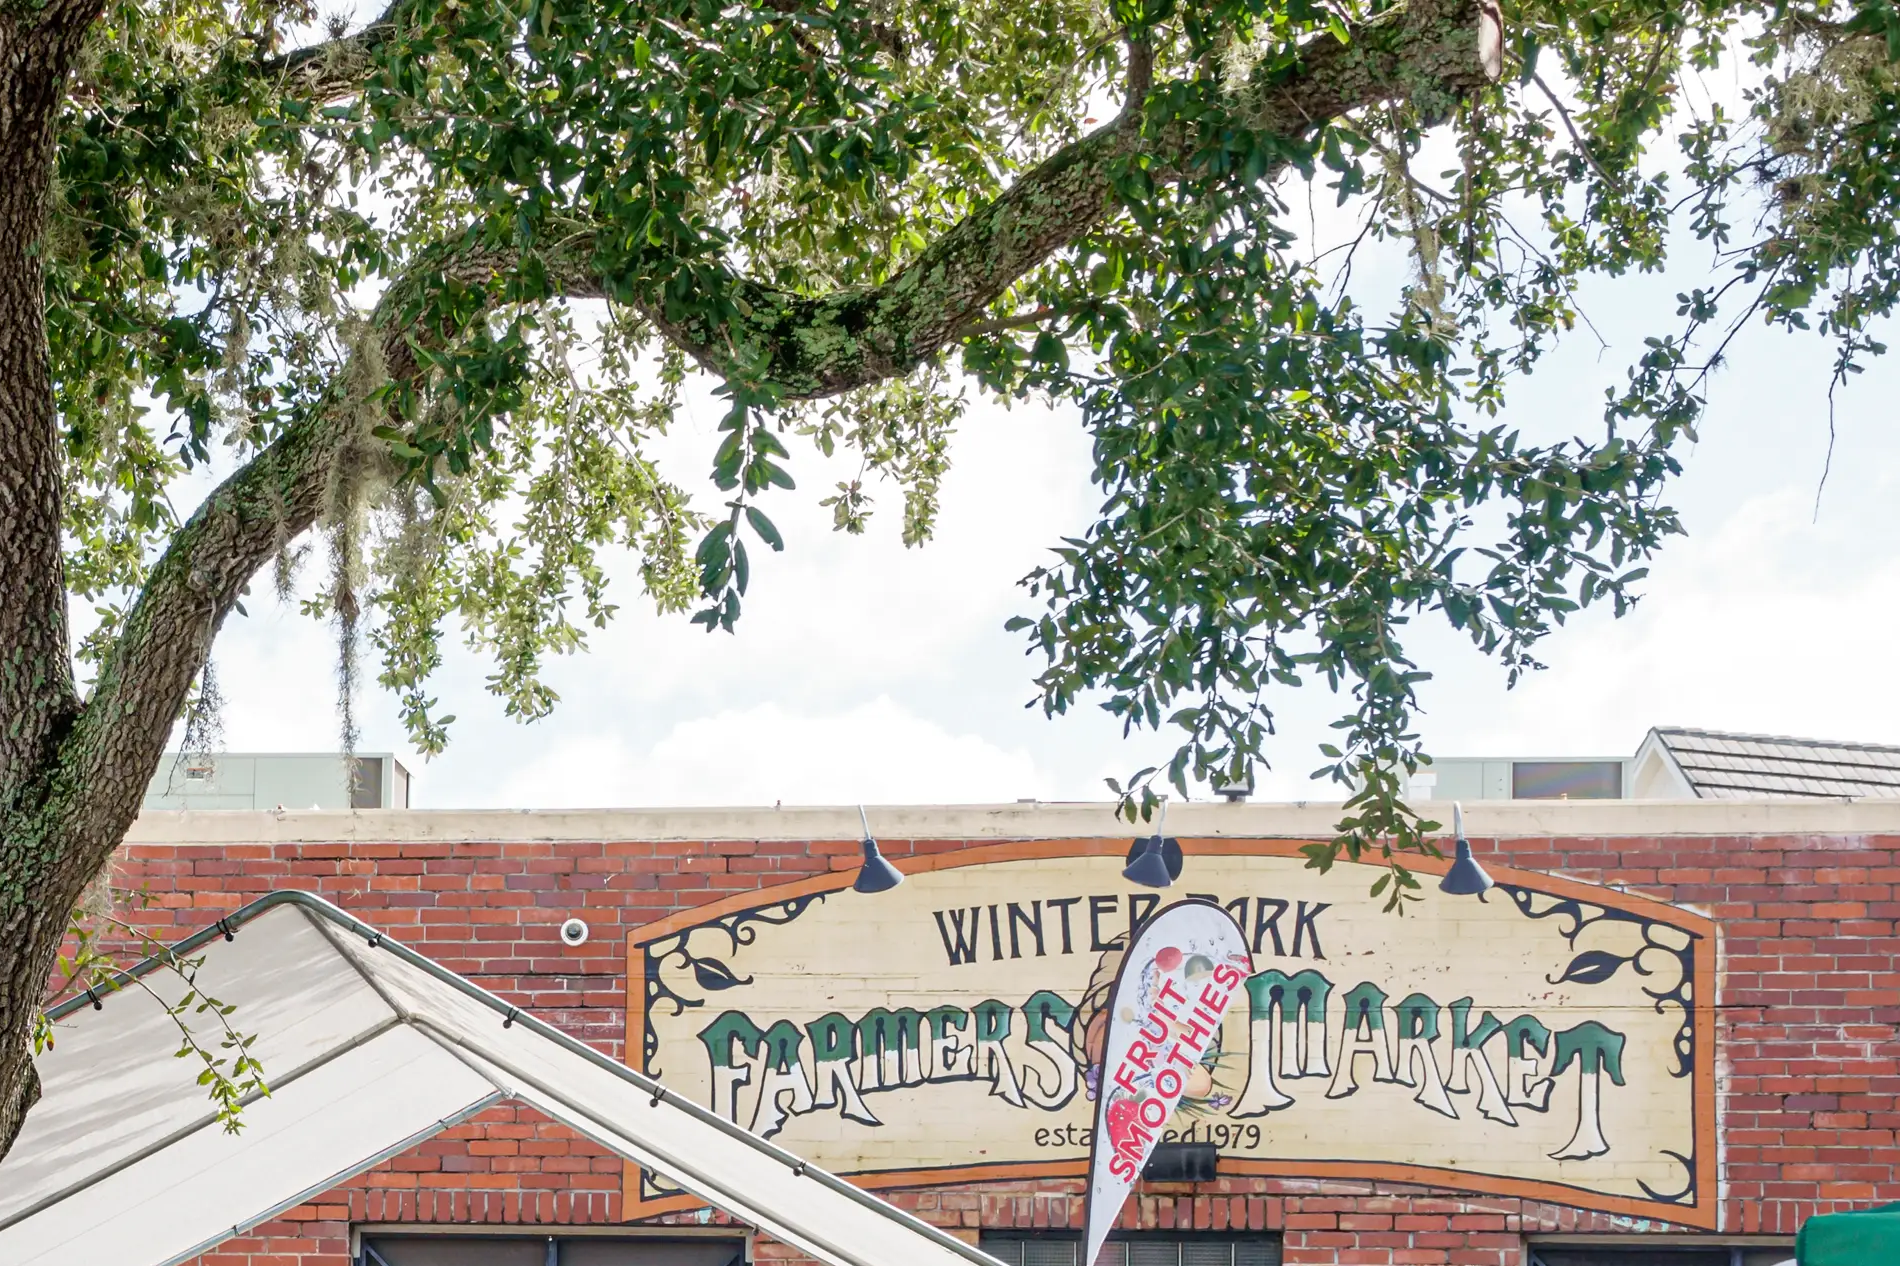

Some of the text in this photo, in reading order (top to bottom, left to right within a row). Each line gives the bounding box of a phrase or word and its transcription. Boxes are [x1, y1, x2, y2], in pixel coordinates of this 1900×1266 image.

[933, 893, 1333, 966] WINTER ARK
[697, 968, 1627, 1160] FARMERS MARKET
[1108, 963, 1241, 1184] SMOOTHIES
[1113, 977, 1188, 1095] FRUIT
[1034, 1119, 1261, 1150] estaed 1979
